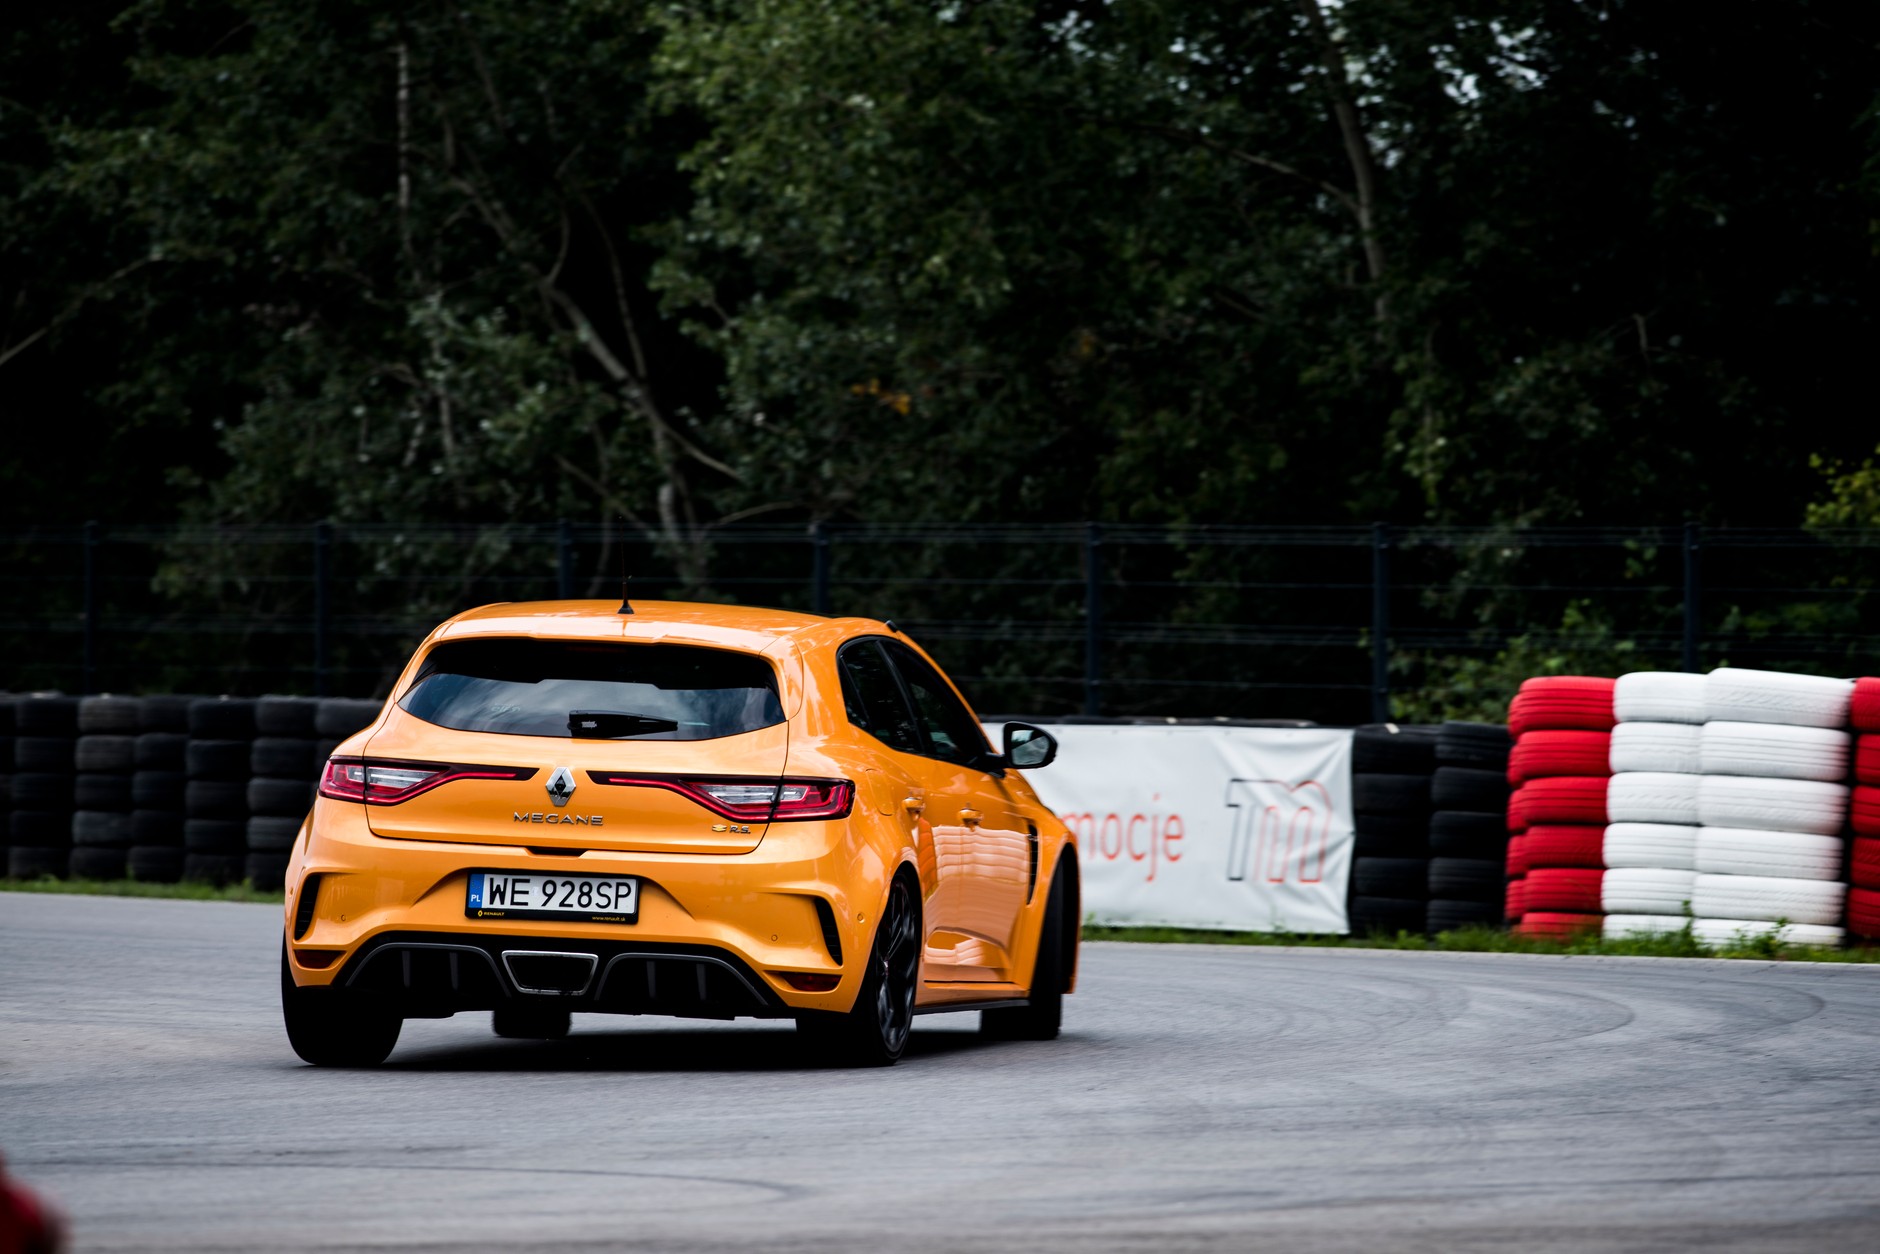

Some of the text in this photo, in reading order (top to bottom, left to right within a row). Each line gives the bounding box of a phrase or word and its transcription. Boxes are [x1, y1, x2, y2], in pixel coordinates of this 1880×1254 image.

[513, 811, 604, 826] MEGANE
[471, 894, 481, 902] PL
[489, 877, 632, 910] WE 928SP
